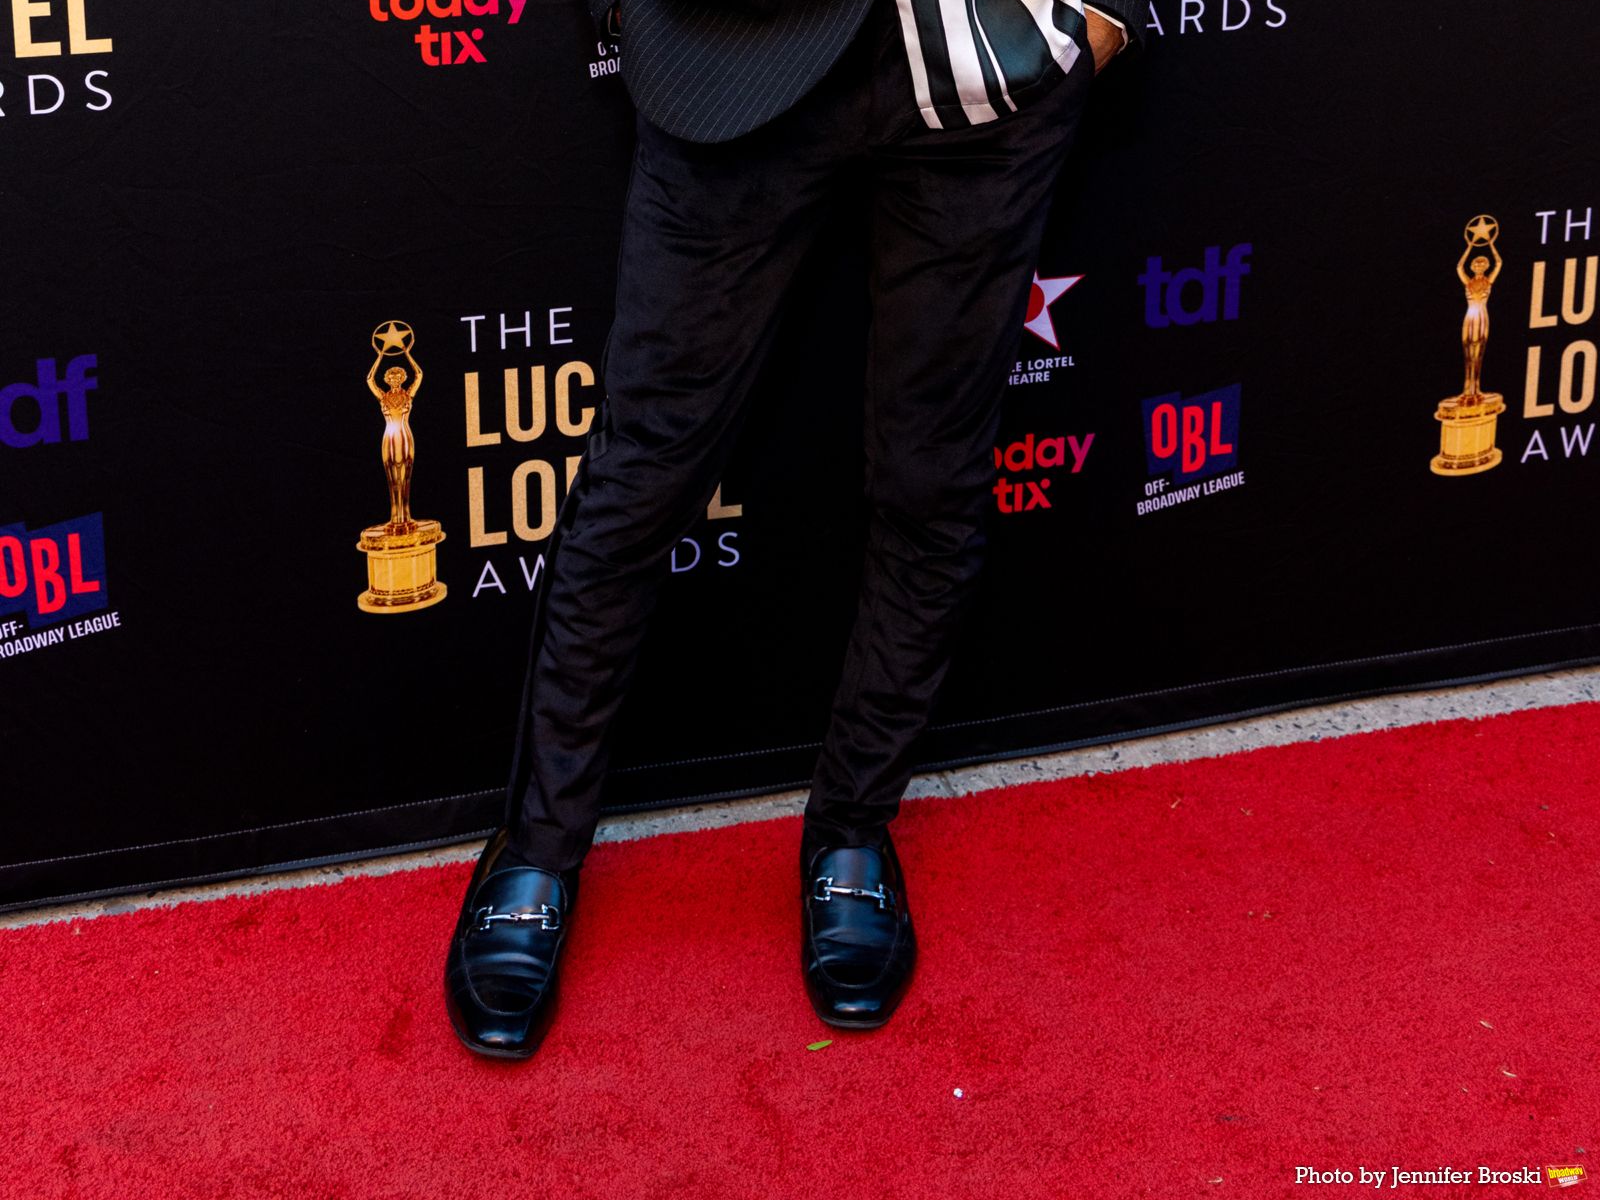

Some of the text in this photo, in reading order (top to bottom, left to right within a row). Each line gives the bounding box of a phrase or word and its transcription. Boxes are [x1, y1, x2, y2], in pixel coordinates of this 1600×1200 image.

[414, 24, 488, 67] tix
[1137, 243, 1253, 328] tdf
[460, 307, 574, 353] THE
[1028, 355, 1075, 371] LORTEL
[1151, 401, 1233, 473] OBL
[1136, 471, 1246, 516] BROADWAY LEAGUE
[1144, 479, 1170, 497] OFF-
[68, 611, 122, 639] LEAGUE
